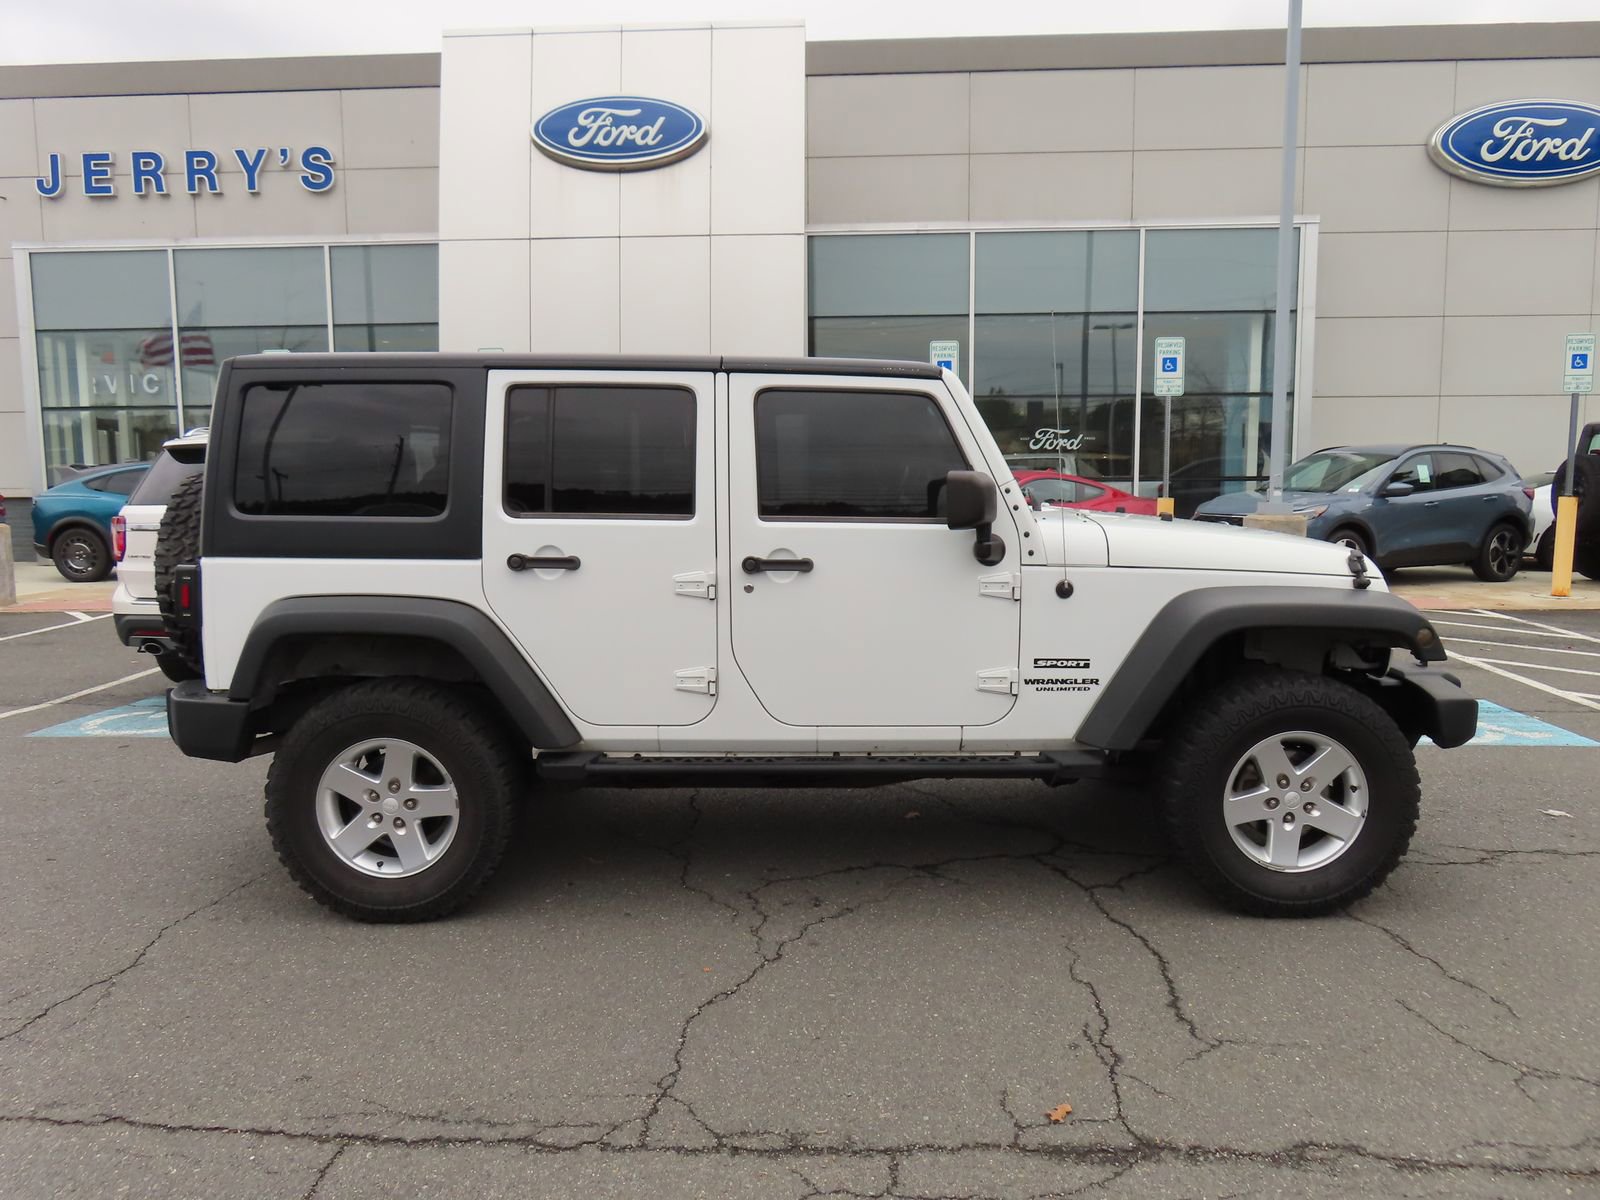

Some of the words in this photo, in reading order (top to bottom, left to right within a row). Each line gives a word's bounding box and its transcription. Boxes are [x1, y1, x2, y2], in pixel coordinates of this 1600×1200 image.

[568, 107, 666, 147] Ford
[1480, 116, 1596, 163] Ford
[36, 146, 335, 197] JERRY'S
[1029, 428, 1084, 450] Ford
[1034, 659, 1090, 668] SPORT
